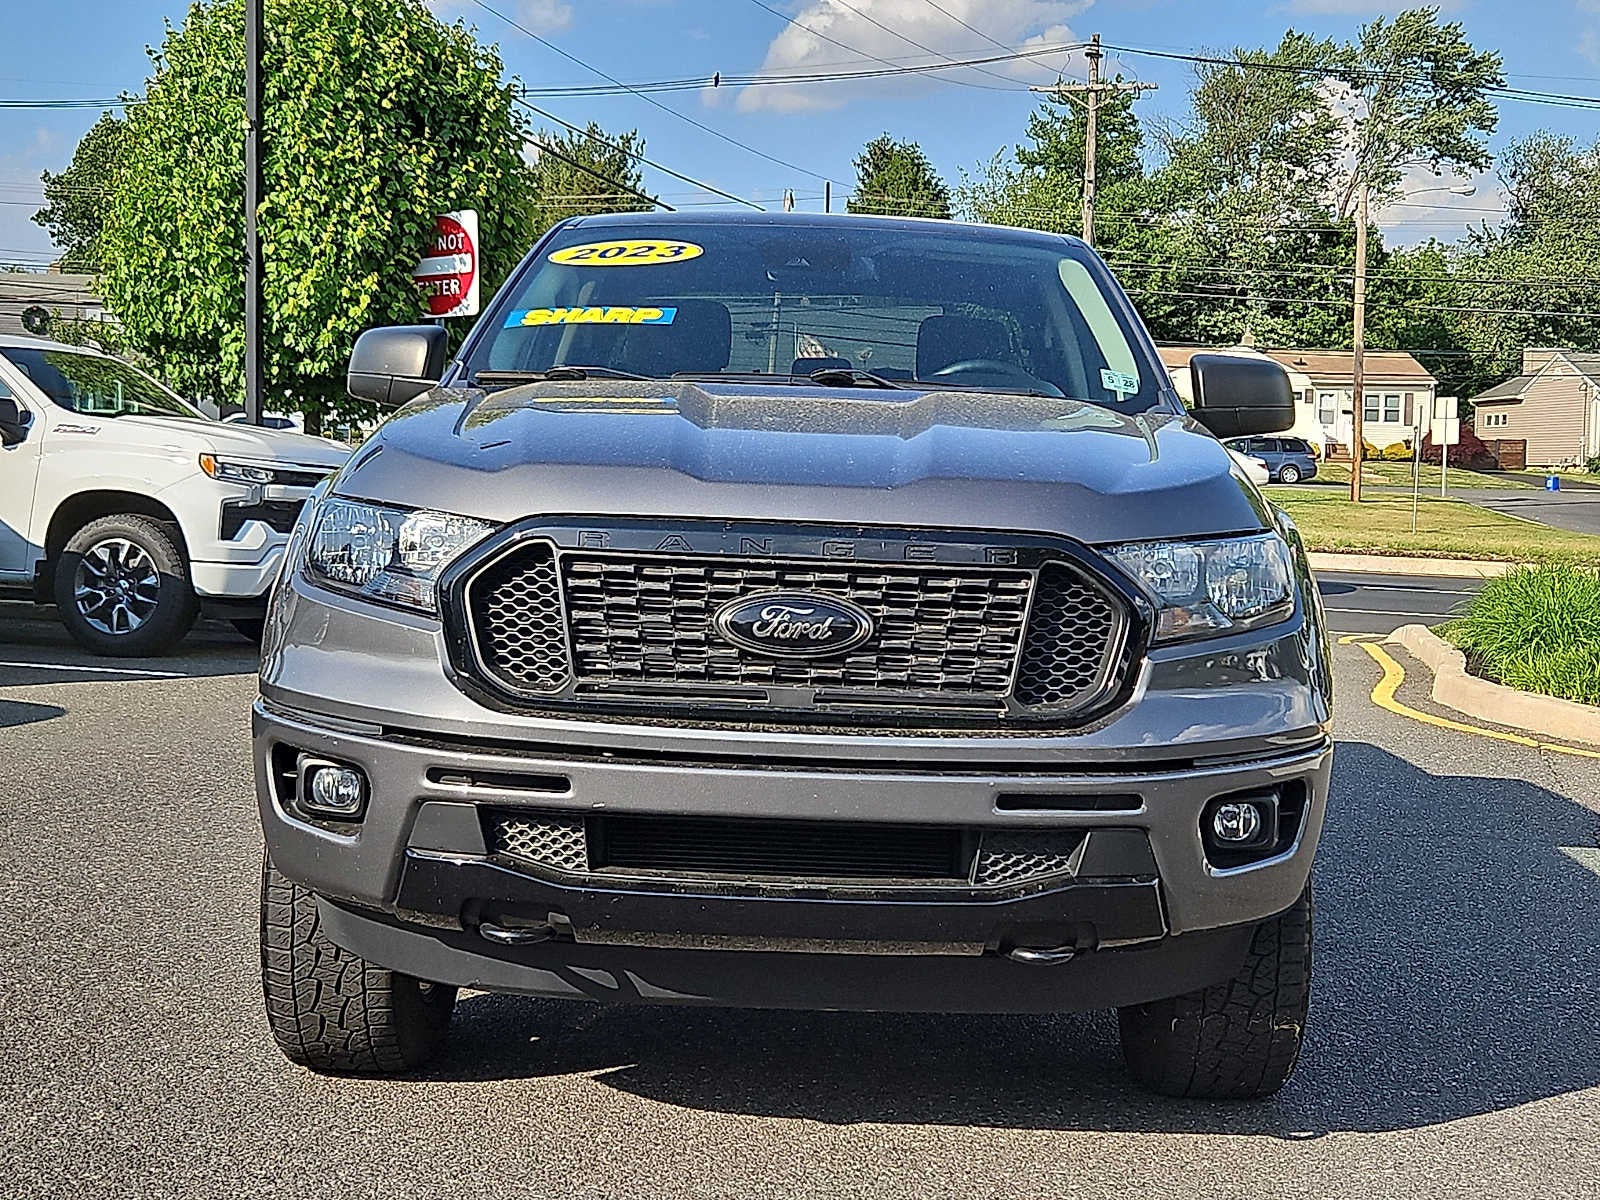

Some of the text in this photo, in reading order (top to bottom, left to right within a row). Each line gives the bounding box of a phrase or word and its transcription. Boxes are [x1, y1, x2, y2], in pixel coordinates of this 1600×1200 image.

[438, 232, 465, 251] NOT
[566, 245, 687, 262] 2023
[418, 279, 460, 296] ETER
[520, 307, 664, 326] SHARP
[576, 530, 1018, 565] RANGER
[751, 604, 838, 641] Ford
